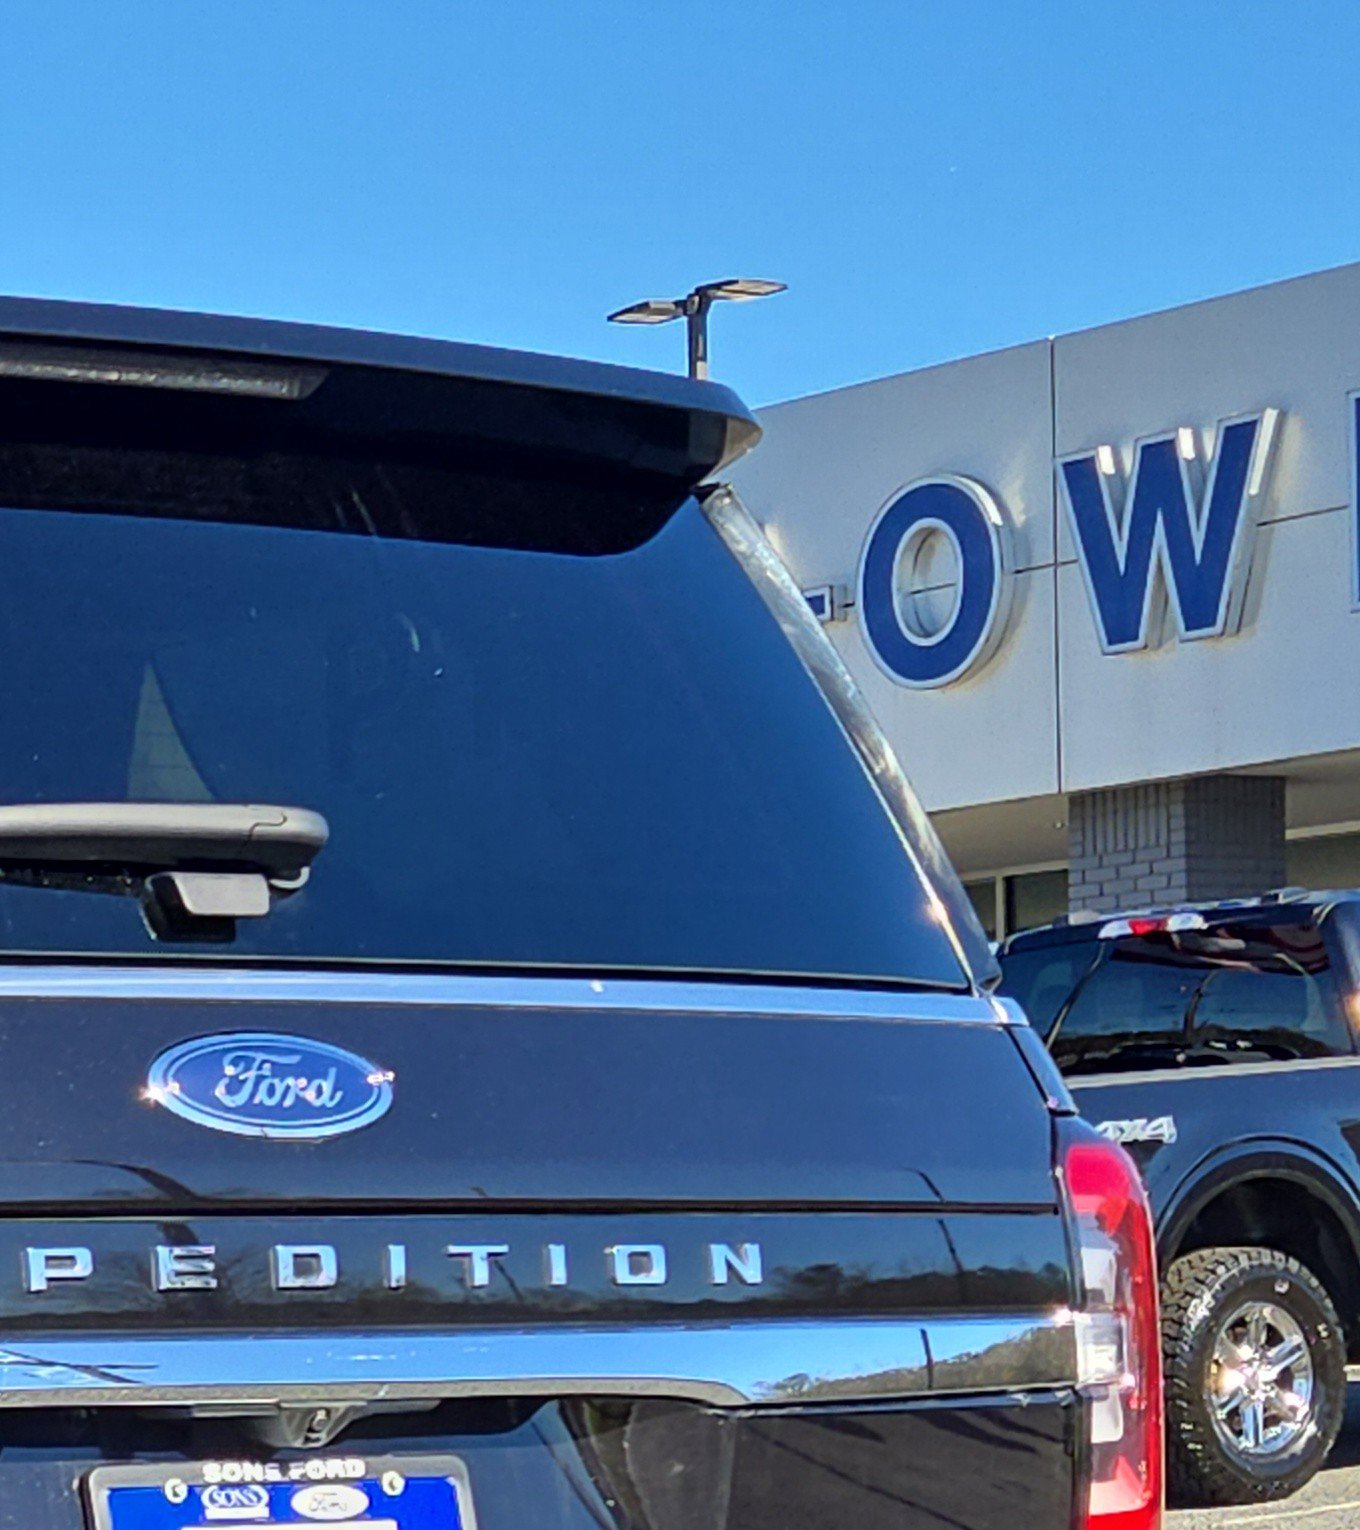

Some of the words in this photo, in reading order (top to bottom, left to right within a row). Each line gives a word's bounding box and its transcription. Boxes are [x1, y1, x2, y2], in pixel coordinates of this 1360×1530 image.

[804, 390, 1360, 690] OW
[214, 1051, 344, 1108] Ford
[202, 1461, 281, 1484] SONS
[289, 1458, 367, 1480] FORD
